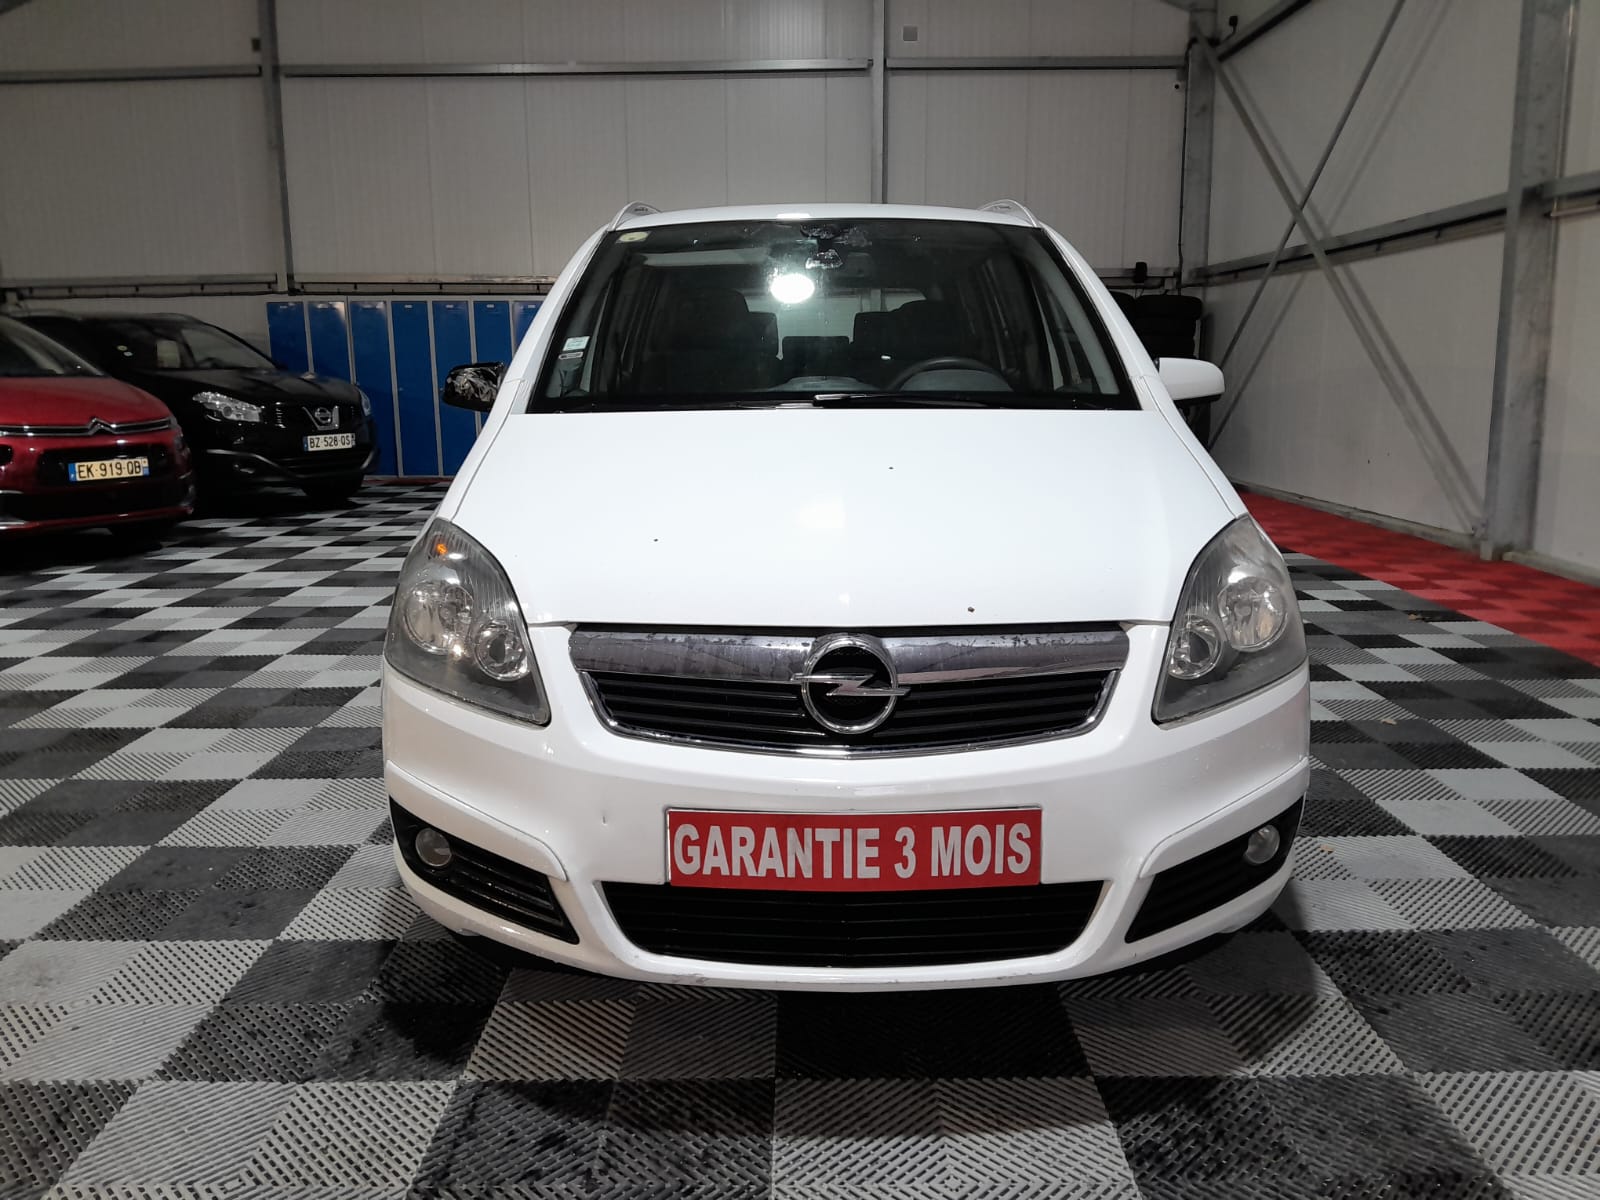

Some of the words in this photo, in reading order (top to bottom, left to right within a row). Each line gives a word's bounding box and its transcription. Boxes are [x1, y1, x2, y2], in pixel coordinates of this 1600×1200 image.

[673, 824, 880, 879] GARANTIE
[894, 826, 917, 879] 3
[930, 822, 1032, 877] MOIS
